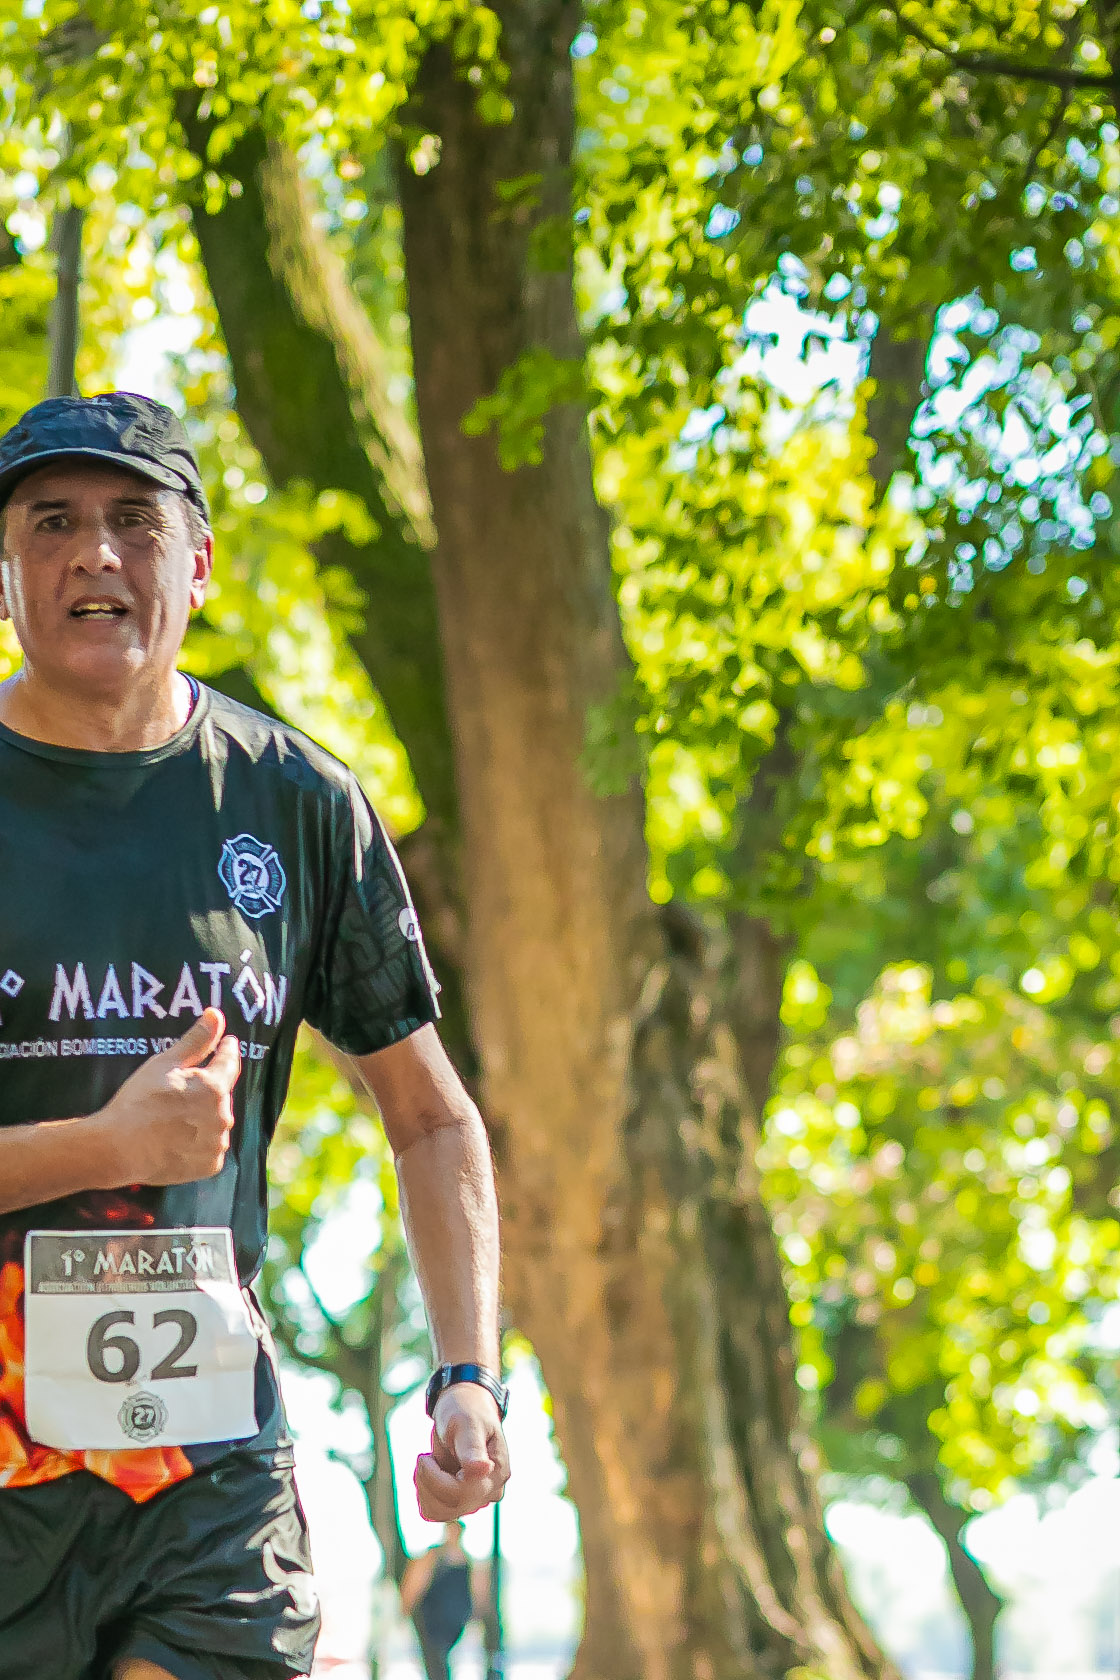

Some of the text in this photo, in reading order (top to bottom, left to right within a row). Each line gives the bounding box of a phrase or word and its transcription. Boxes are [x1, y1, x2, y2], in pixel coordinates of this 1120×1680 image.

[48, 949, 287, 1027] MARATÓN
[60, 1037, 148, 1056] BOMBEROS
[86, 1309, 198, 1383] 62
